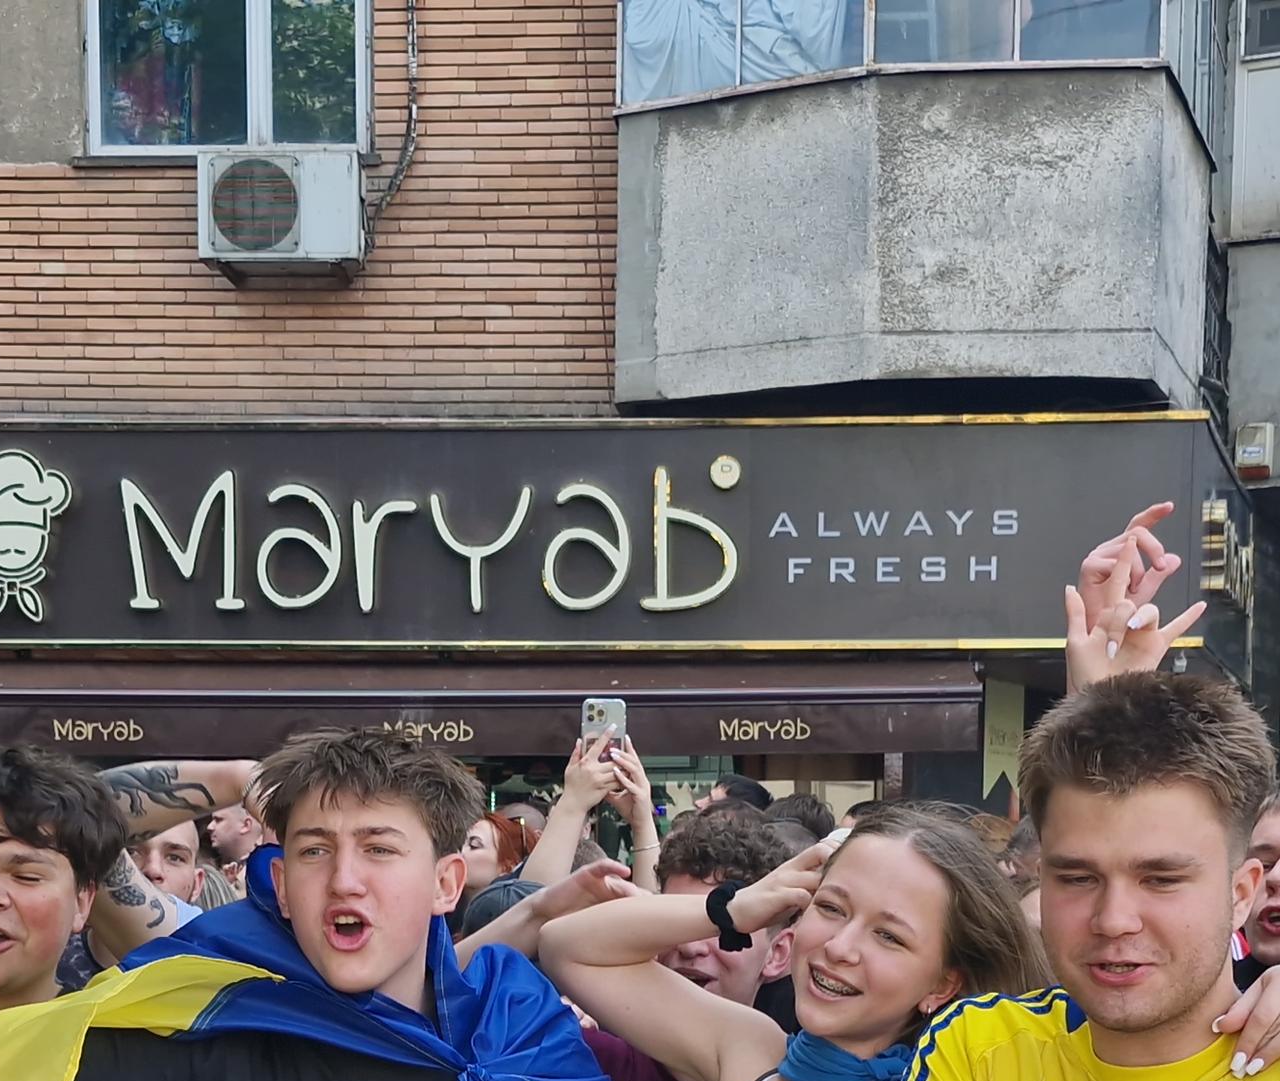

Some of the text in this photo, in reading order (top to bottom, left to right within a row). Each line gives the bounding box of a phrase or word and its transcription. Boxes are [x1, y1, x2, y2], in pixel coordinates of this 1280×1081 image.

[769, 509, 1019, 538] ALWAYS
[121, 467, 738, 613] Maryab
[787, 555, 998, 583] FRESH
[53, 718, 144, 741] Maryab
[719, 717, 811, 741] Maryab
